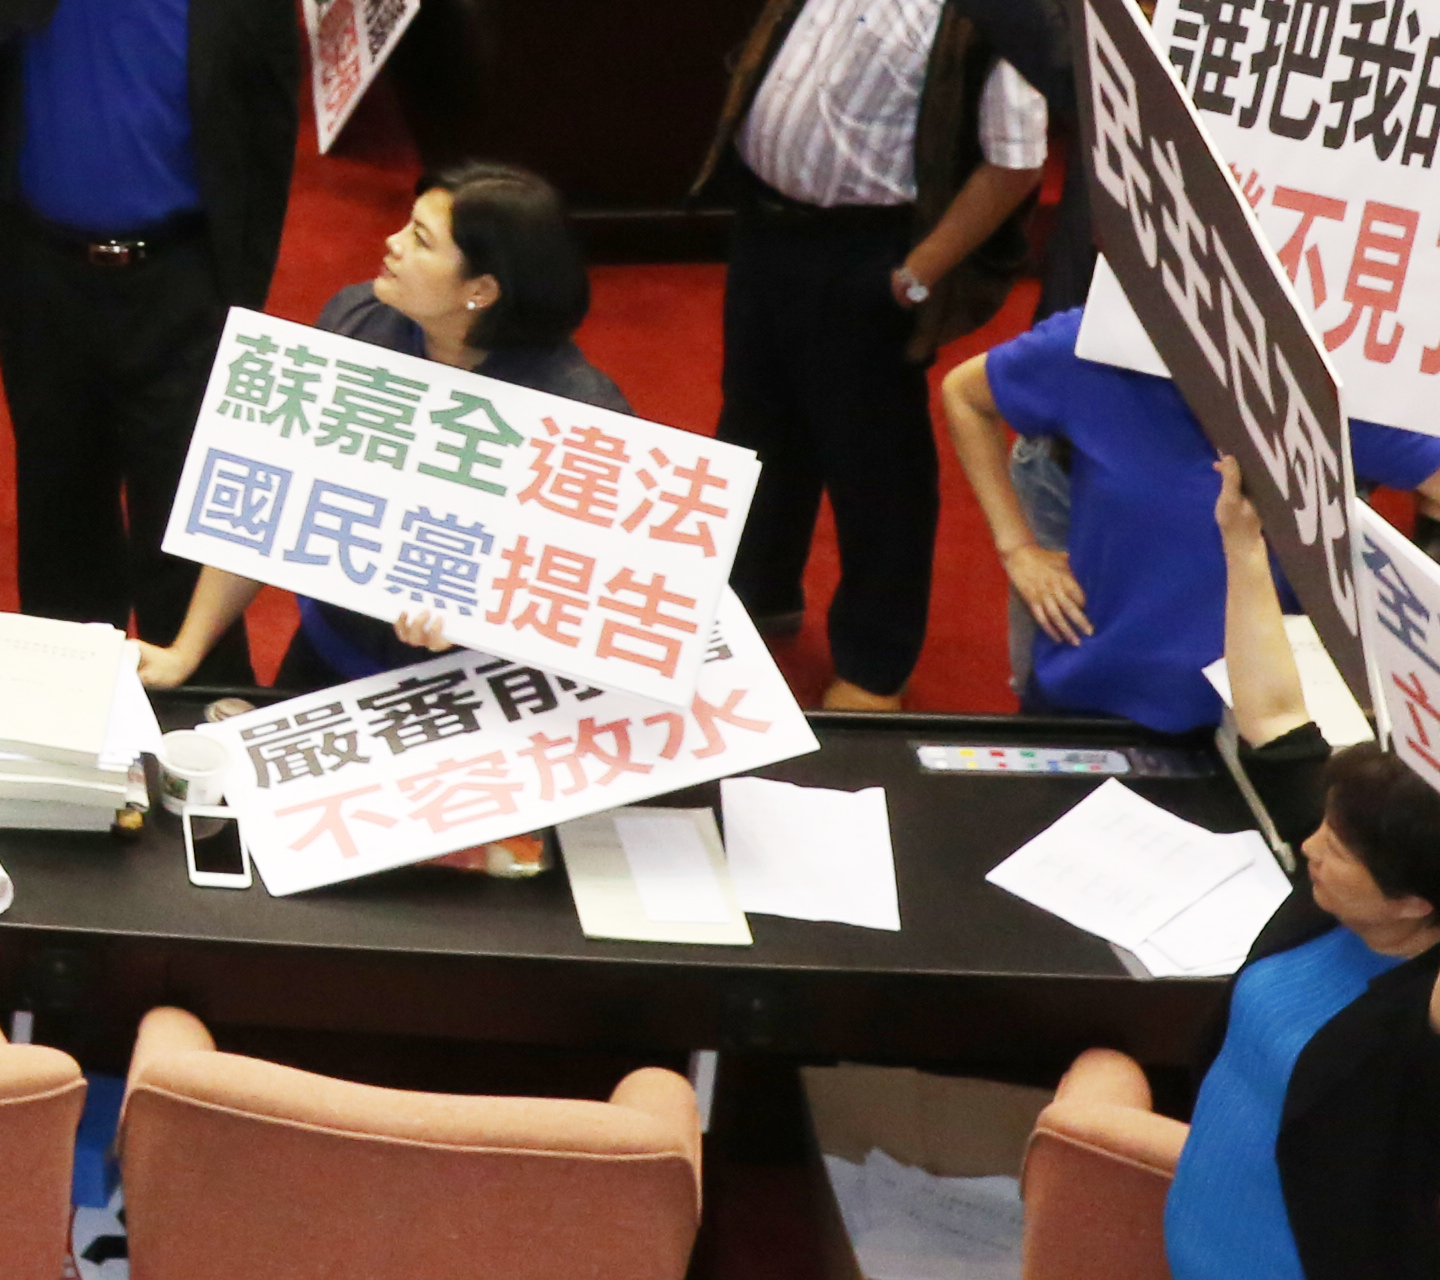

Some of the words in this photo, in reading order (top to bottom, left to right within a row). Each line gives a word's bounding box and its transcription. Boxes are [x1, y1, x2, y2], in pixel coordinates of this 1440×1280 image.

[215, 333, 731, 559] 蘇嘉全違法
[185, 447, 699, 679] 國民黨提告
[272, 688, 774, 864] 不容放水
